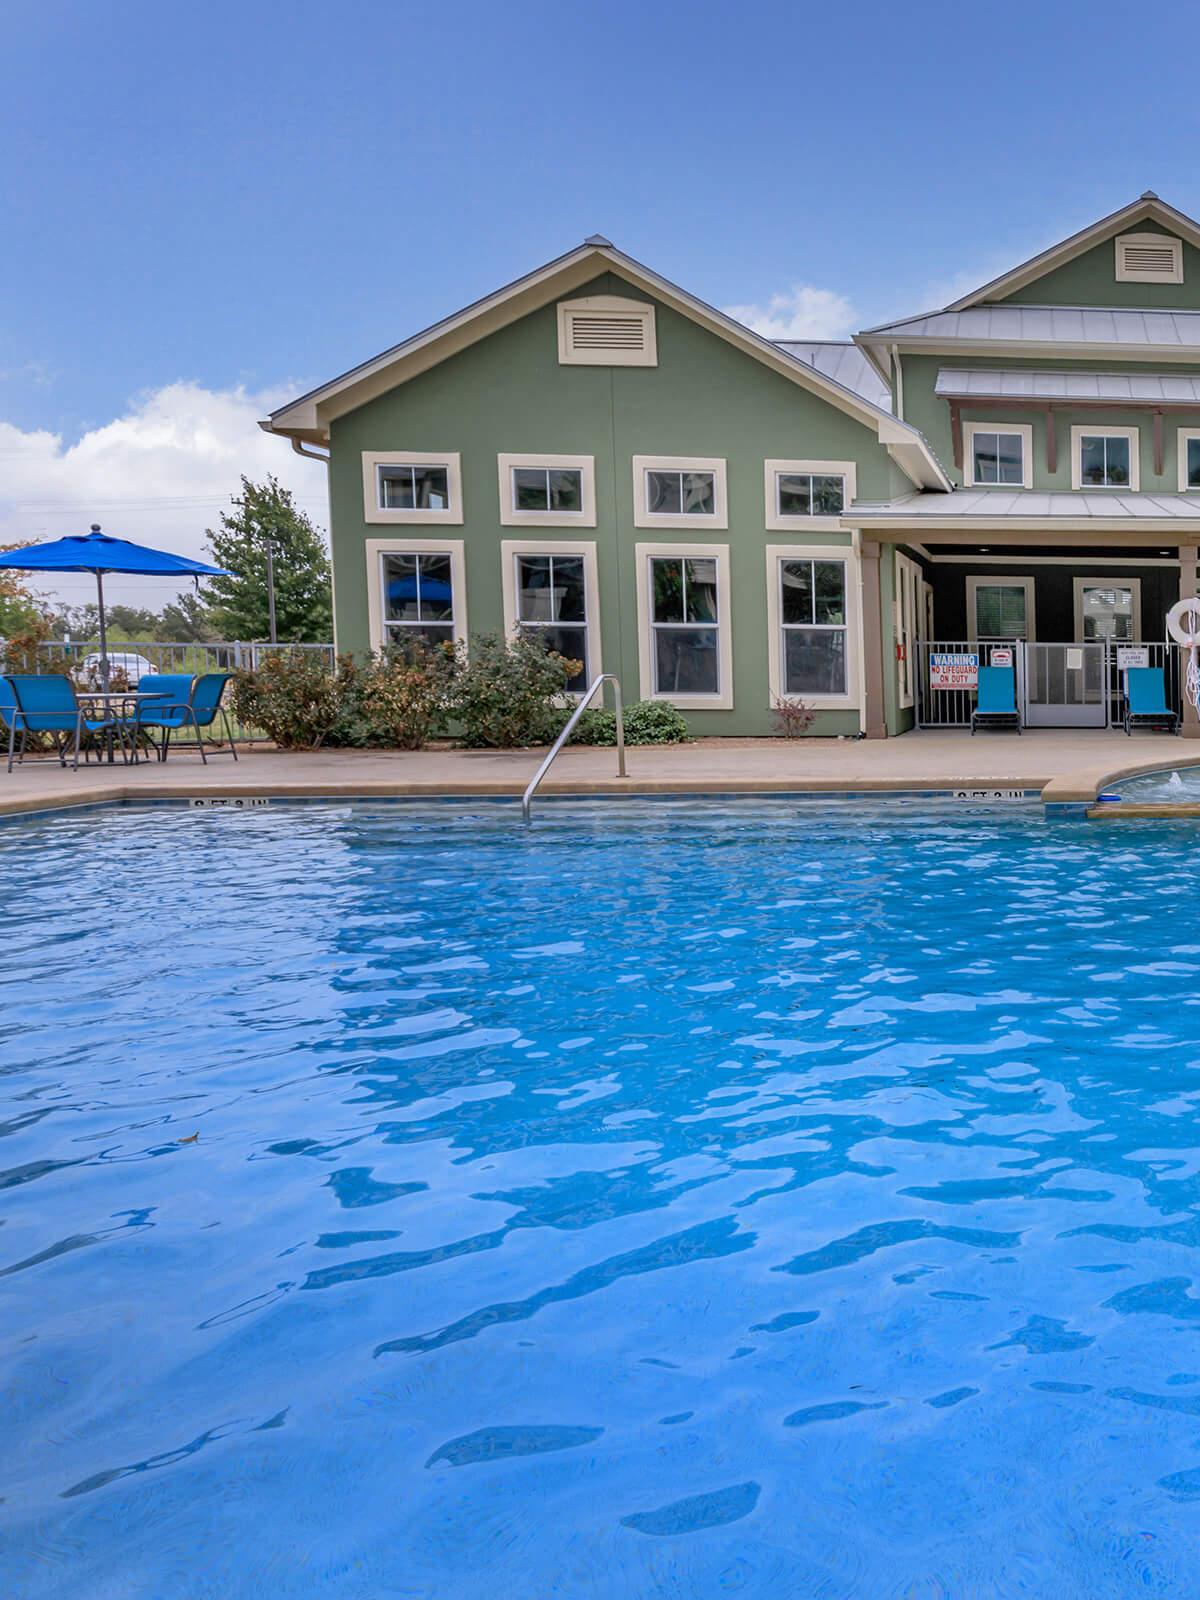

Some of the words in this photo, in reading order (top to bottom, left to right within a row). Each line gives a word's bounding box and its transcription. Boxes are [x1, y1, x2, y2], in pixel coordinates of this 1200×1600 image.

[933, 654, 975, 666] WARNING
[932, 666, 940, 674] NO
[942, 666, 977, 674] LIFEGUARD
[940, 674, 949, 682] ON
[952, 674, 968, 682] DUTY
